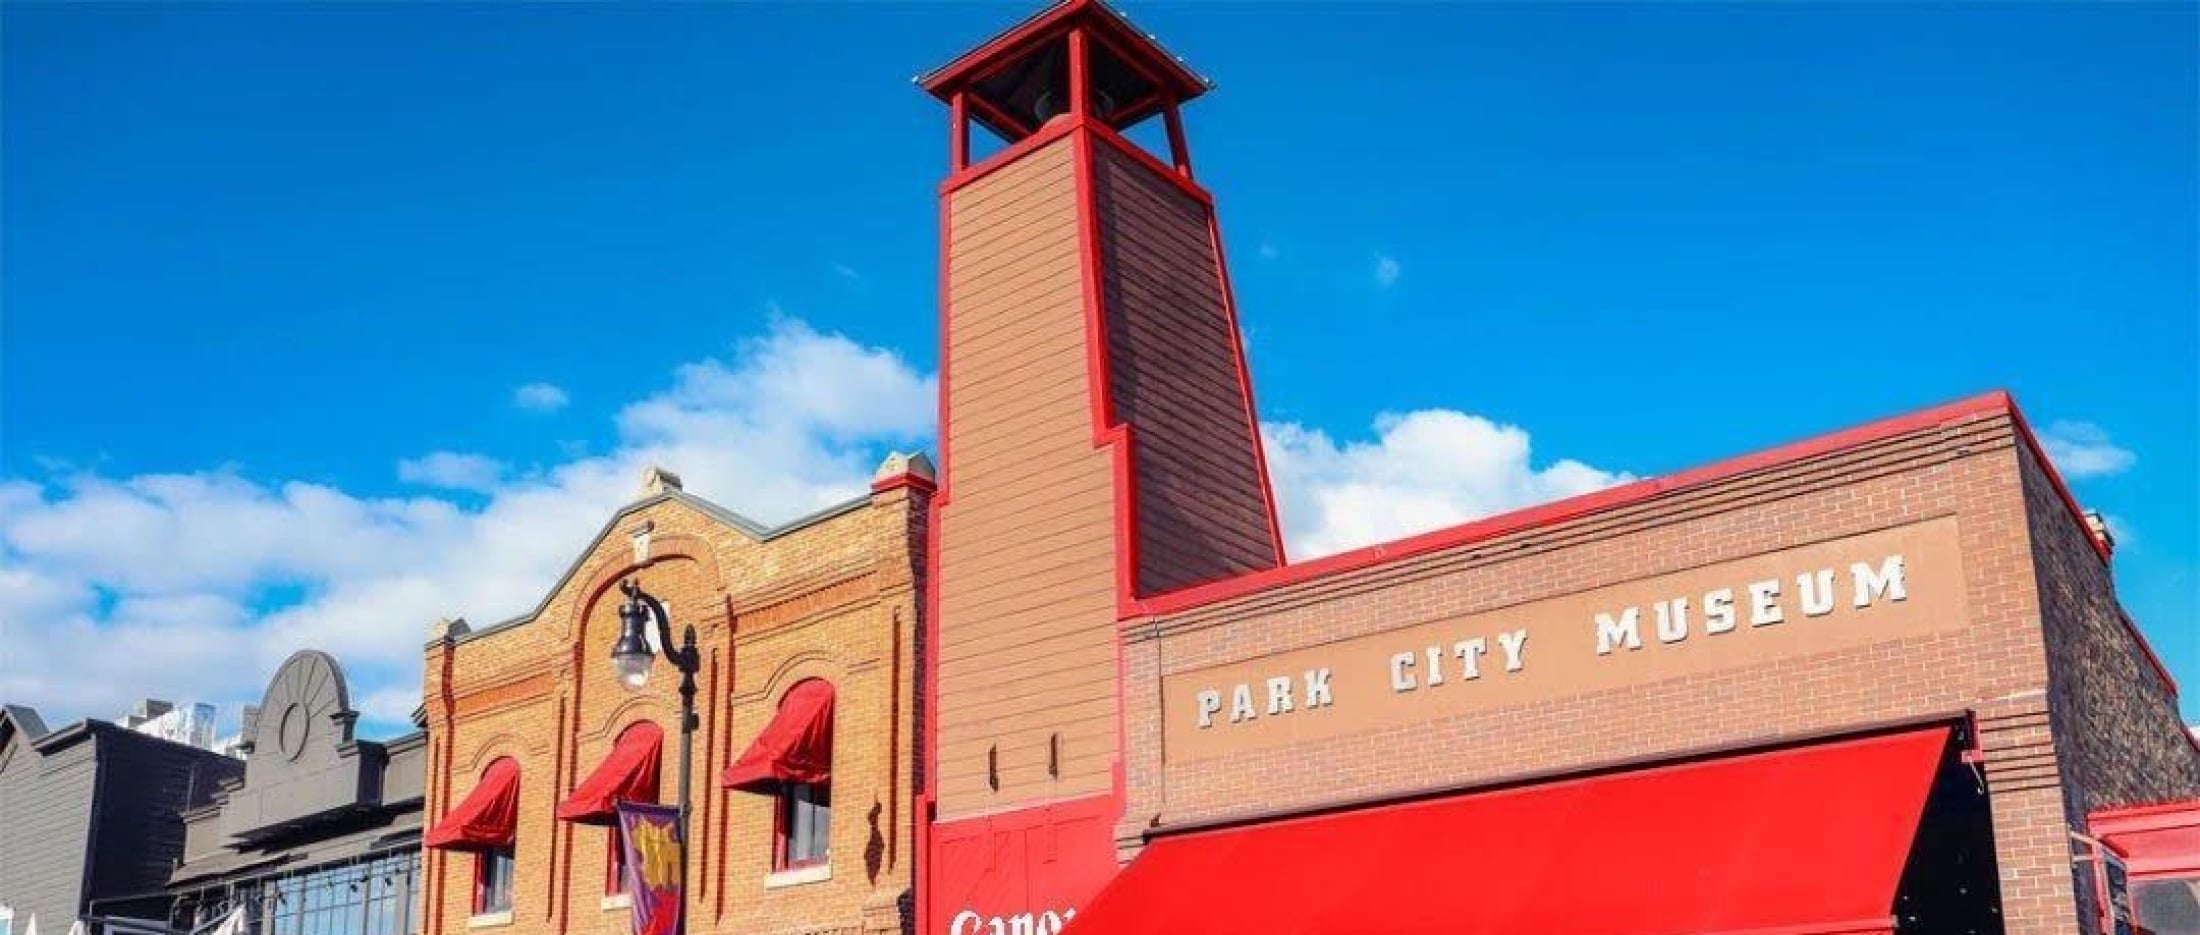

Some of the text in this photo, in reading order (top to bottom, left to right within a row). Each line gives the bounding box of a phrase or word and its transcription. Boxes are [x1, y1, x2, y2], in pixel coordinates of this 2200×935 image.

[1197, 554, 1907, 729] PARK CITY MUSEUM
